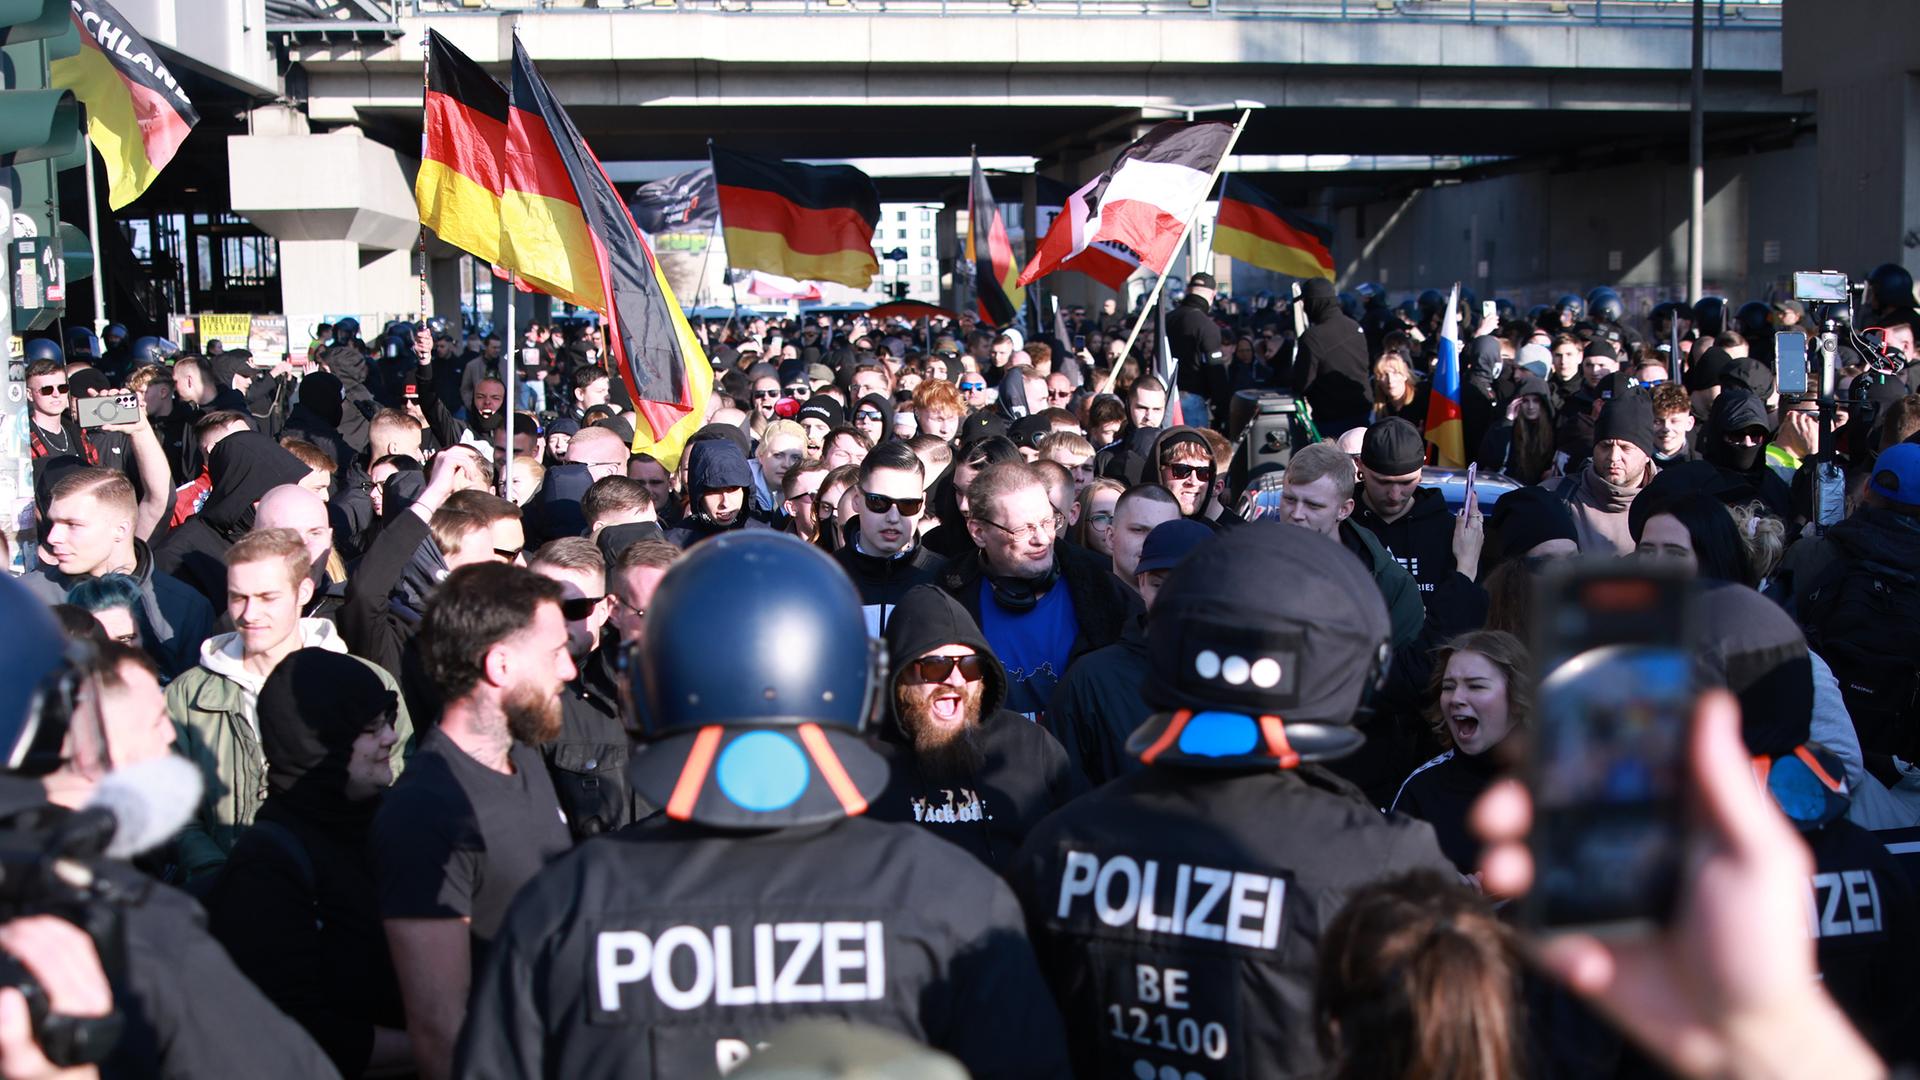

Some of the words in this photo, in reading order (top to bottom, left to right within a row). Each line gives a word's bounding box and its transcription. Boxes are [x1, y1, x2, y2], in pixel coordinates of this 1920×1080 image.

[1057, 850, 1286, 950] POLIZEI
[597, 921, 885, 1011] POLIZEI
[1136, 964, 1189, 1009] BE
[1108, 1004, 1228, 1060] 12100
